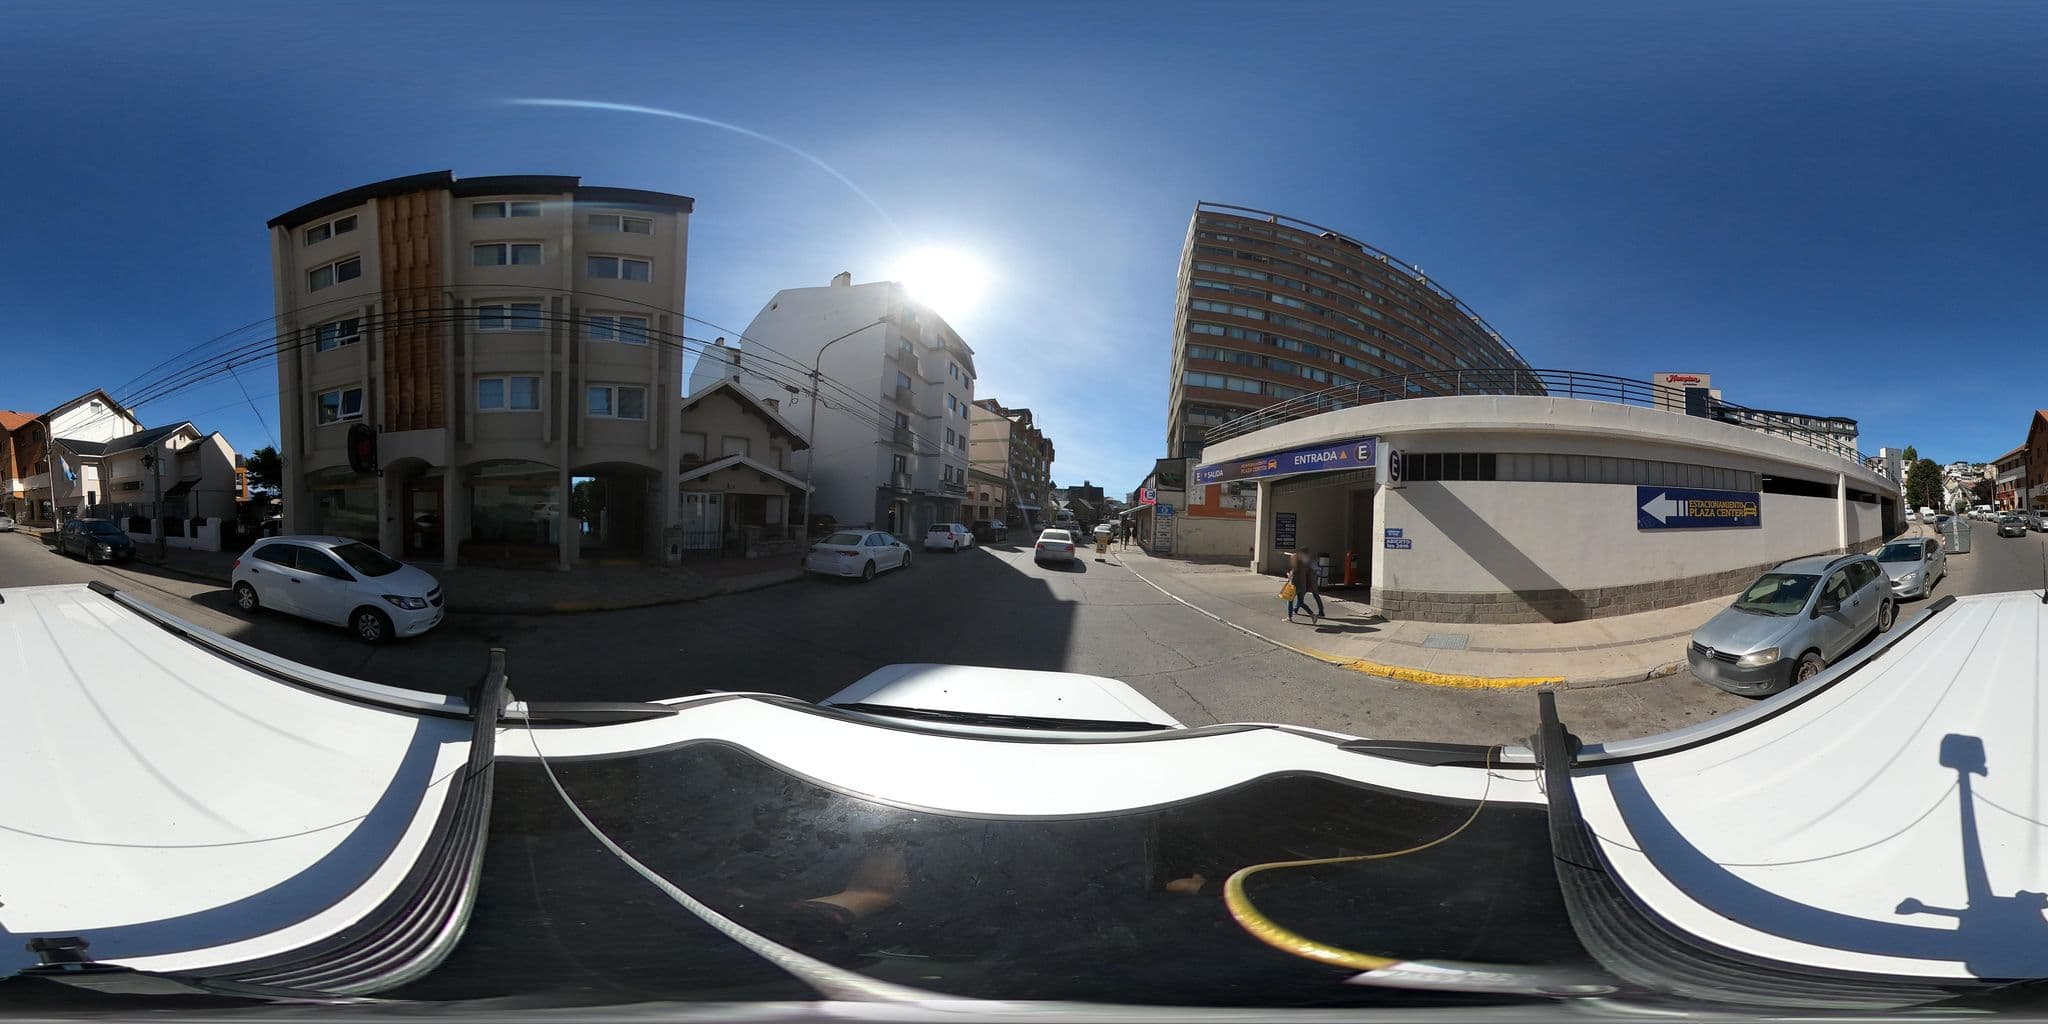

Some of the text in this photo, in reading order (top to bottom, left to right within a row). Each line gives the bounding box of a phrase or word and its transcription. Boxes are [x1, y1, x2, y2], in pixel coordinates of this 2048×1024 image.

[1294, 450, 1338, 465] ENTRADA
[1358, 445, 1368, 460] E
[1391, 456, 1399, 477] E
[1207, 469, 1224, 479] SALIDA
[1146, 490, 1153, 499] E
[1689, 500, 1745, 509] ESTACIONAMIENTO
[1690, 508, 1745, 517] PLAZA CENTER
